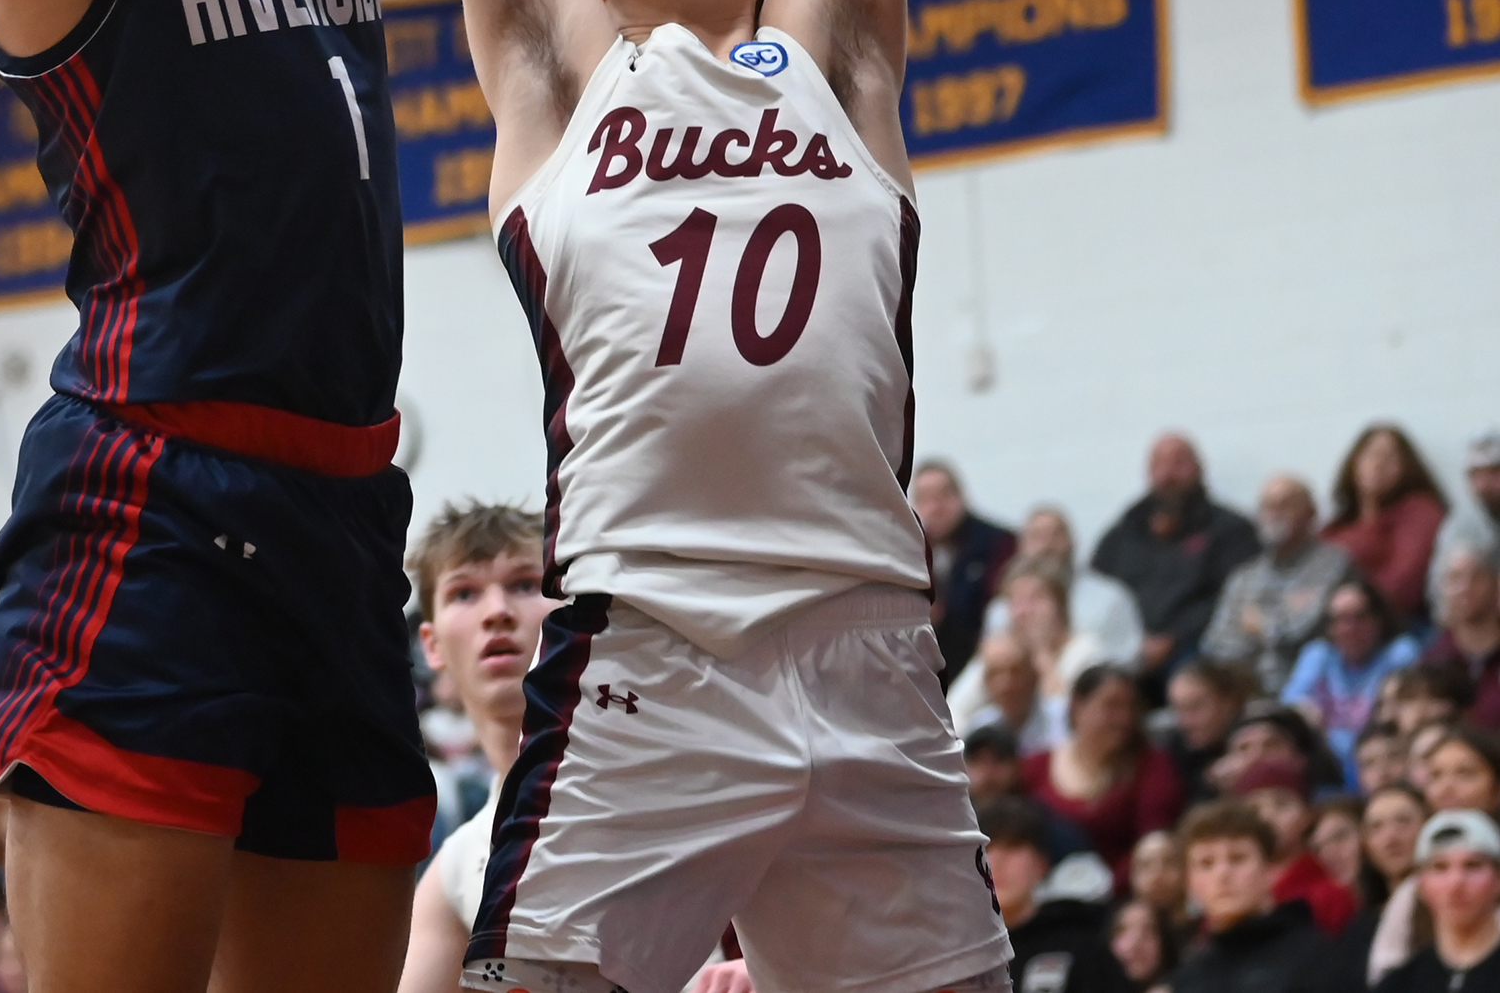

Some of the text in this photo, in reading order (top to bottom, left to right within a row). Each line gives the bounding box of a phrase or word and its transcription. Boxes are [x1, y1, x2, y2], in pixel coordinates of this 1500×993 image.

[328, 55, 370, 180] 1
[586, 106, 853, 196] Bucks
[648, 203, 822, 367] 10
